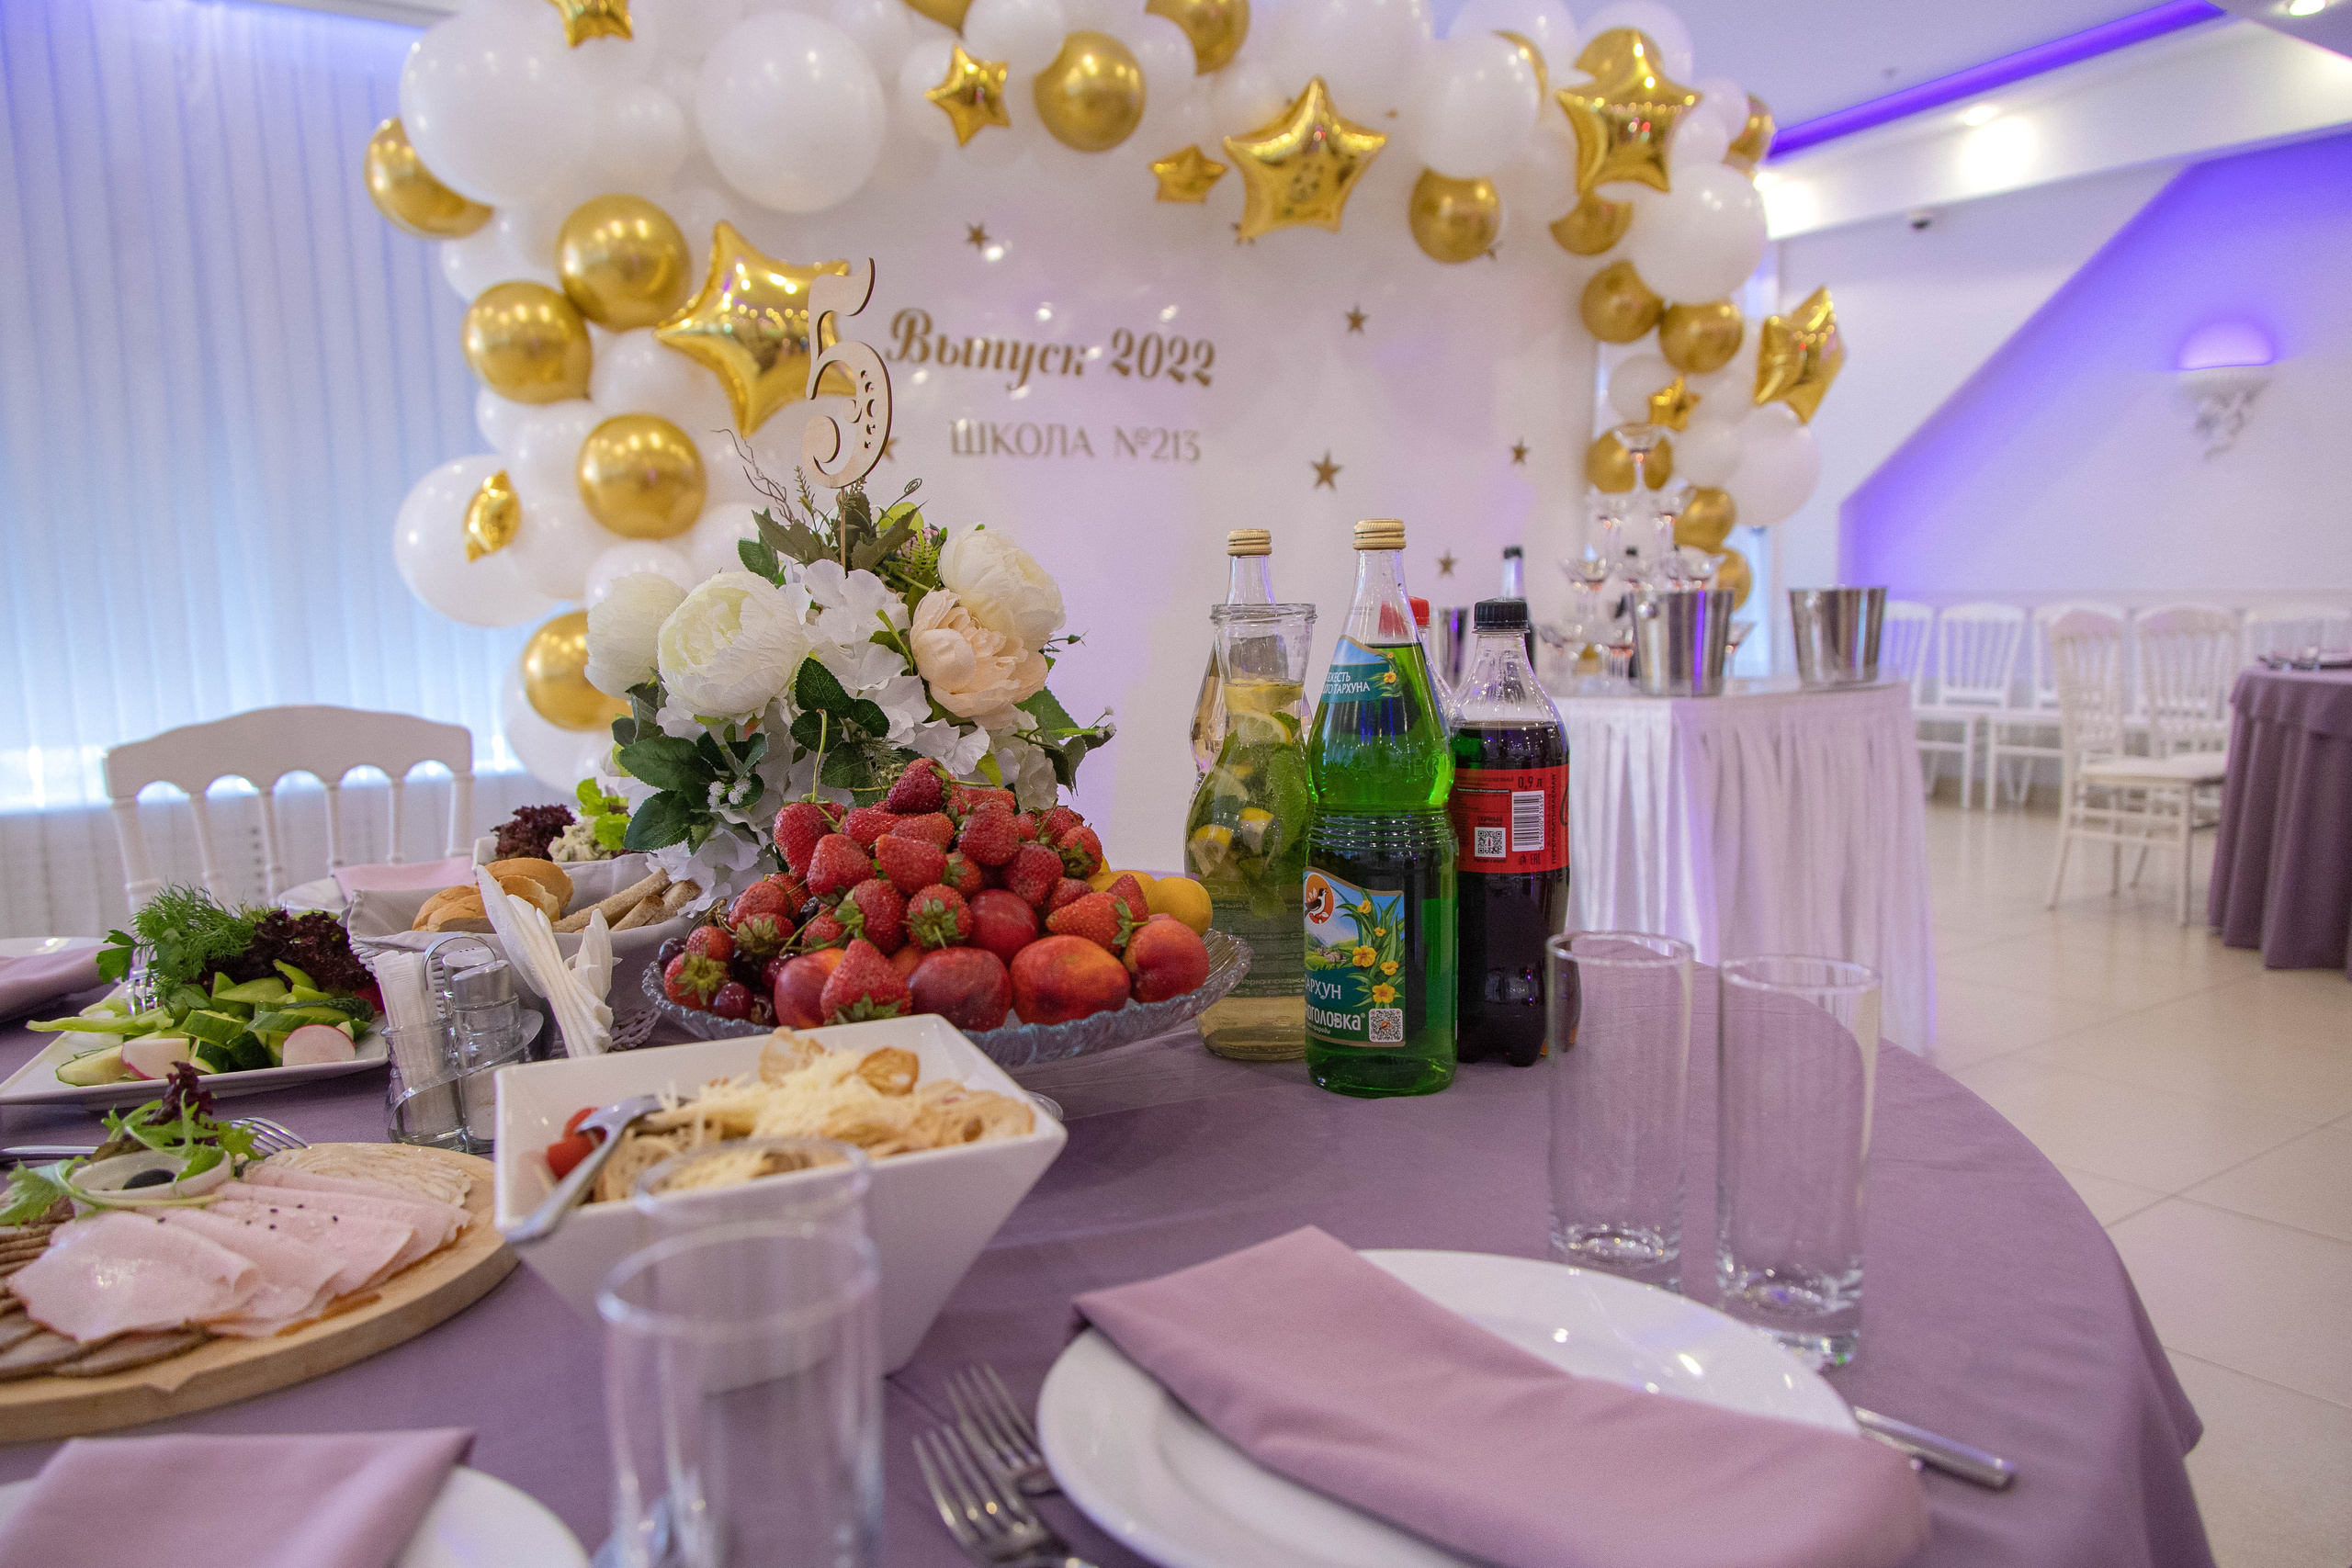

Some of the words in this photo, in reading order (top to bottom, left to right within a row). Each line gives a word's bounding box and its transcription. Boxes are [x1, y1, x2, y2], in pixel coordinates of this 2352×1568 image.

[802, 257, 892, 489] 5
[886, 307, 1087, 391] Выпуск
[1109, 327, 1216, 387] 2022
[949, 420, 1094, 457] ШКОЛА
[1113, 423, 1201, 462] №213
[1334, 682, 1371, 694] ТАРХУНА
